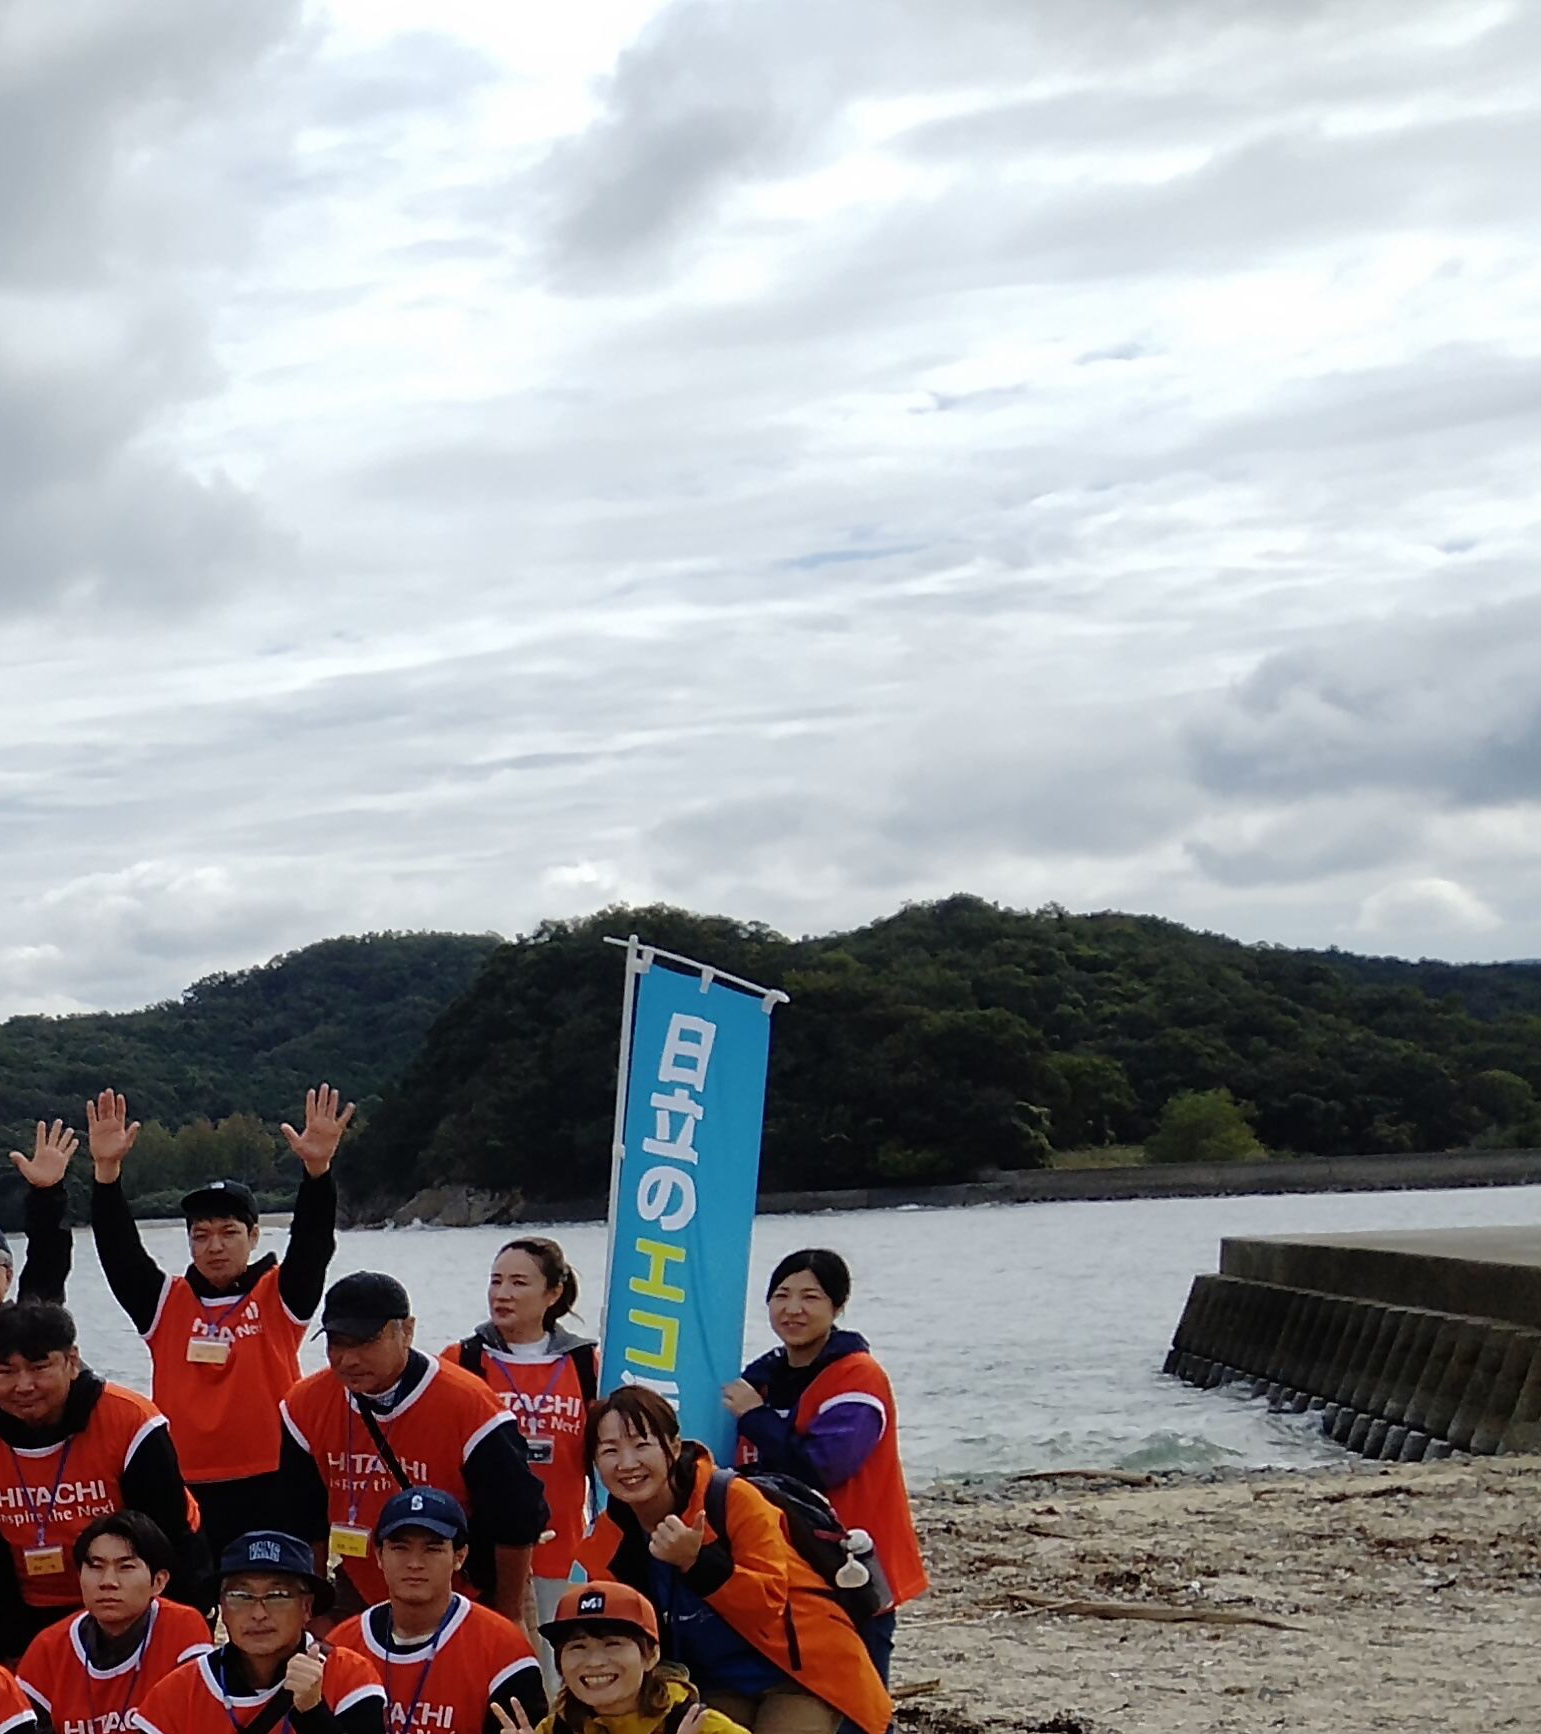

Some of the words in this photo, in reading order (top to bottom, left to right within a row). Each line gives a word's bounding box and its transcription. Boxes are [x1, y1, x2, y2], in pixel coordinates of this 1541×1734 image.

[500, 1391, 582, 1418] TACHI
[326, 1451, 428, 1483] HTAHI
[77, 1499, 116, 1519] Next
[391, 1701, 455, 1730] ACHI
